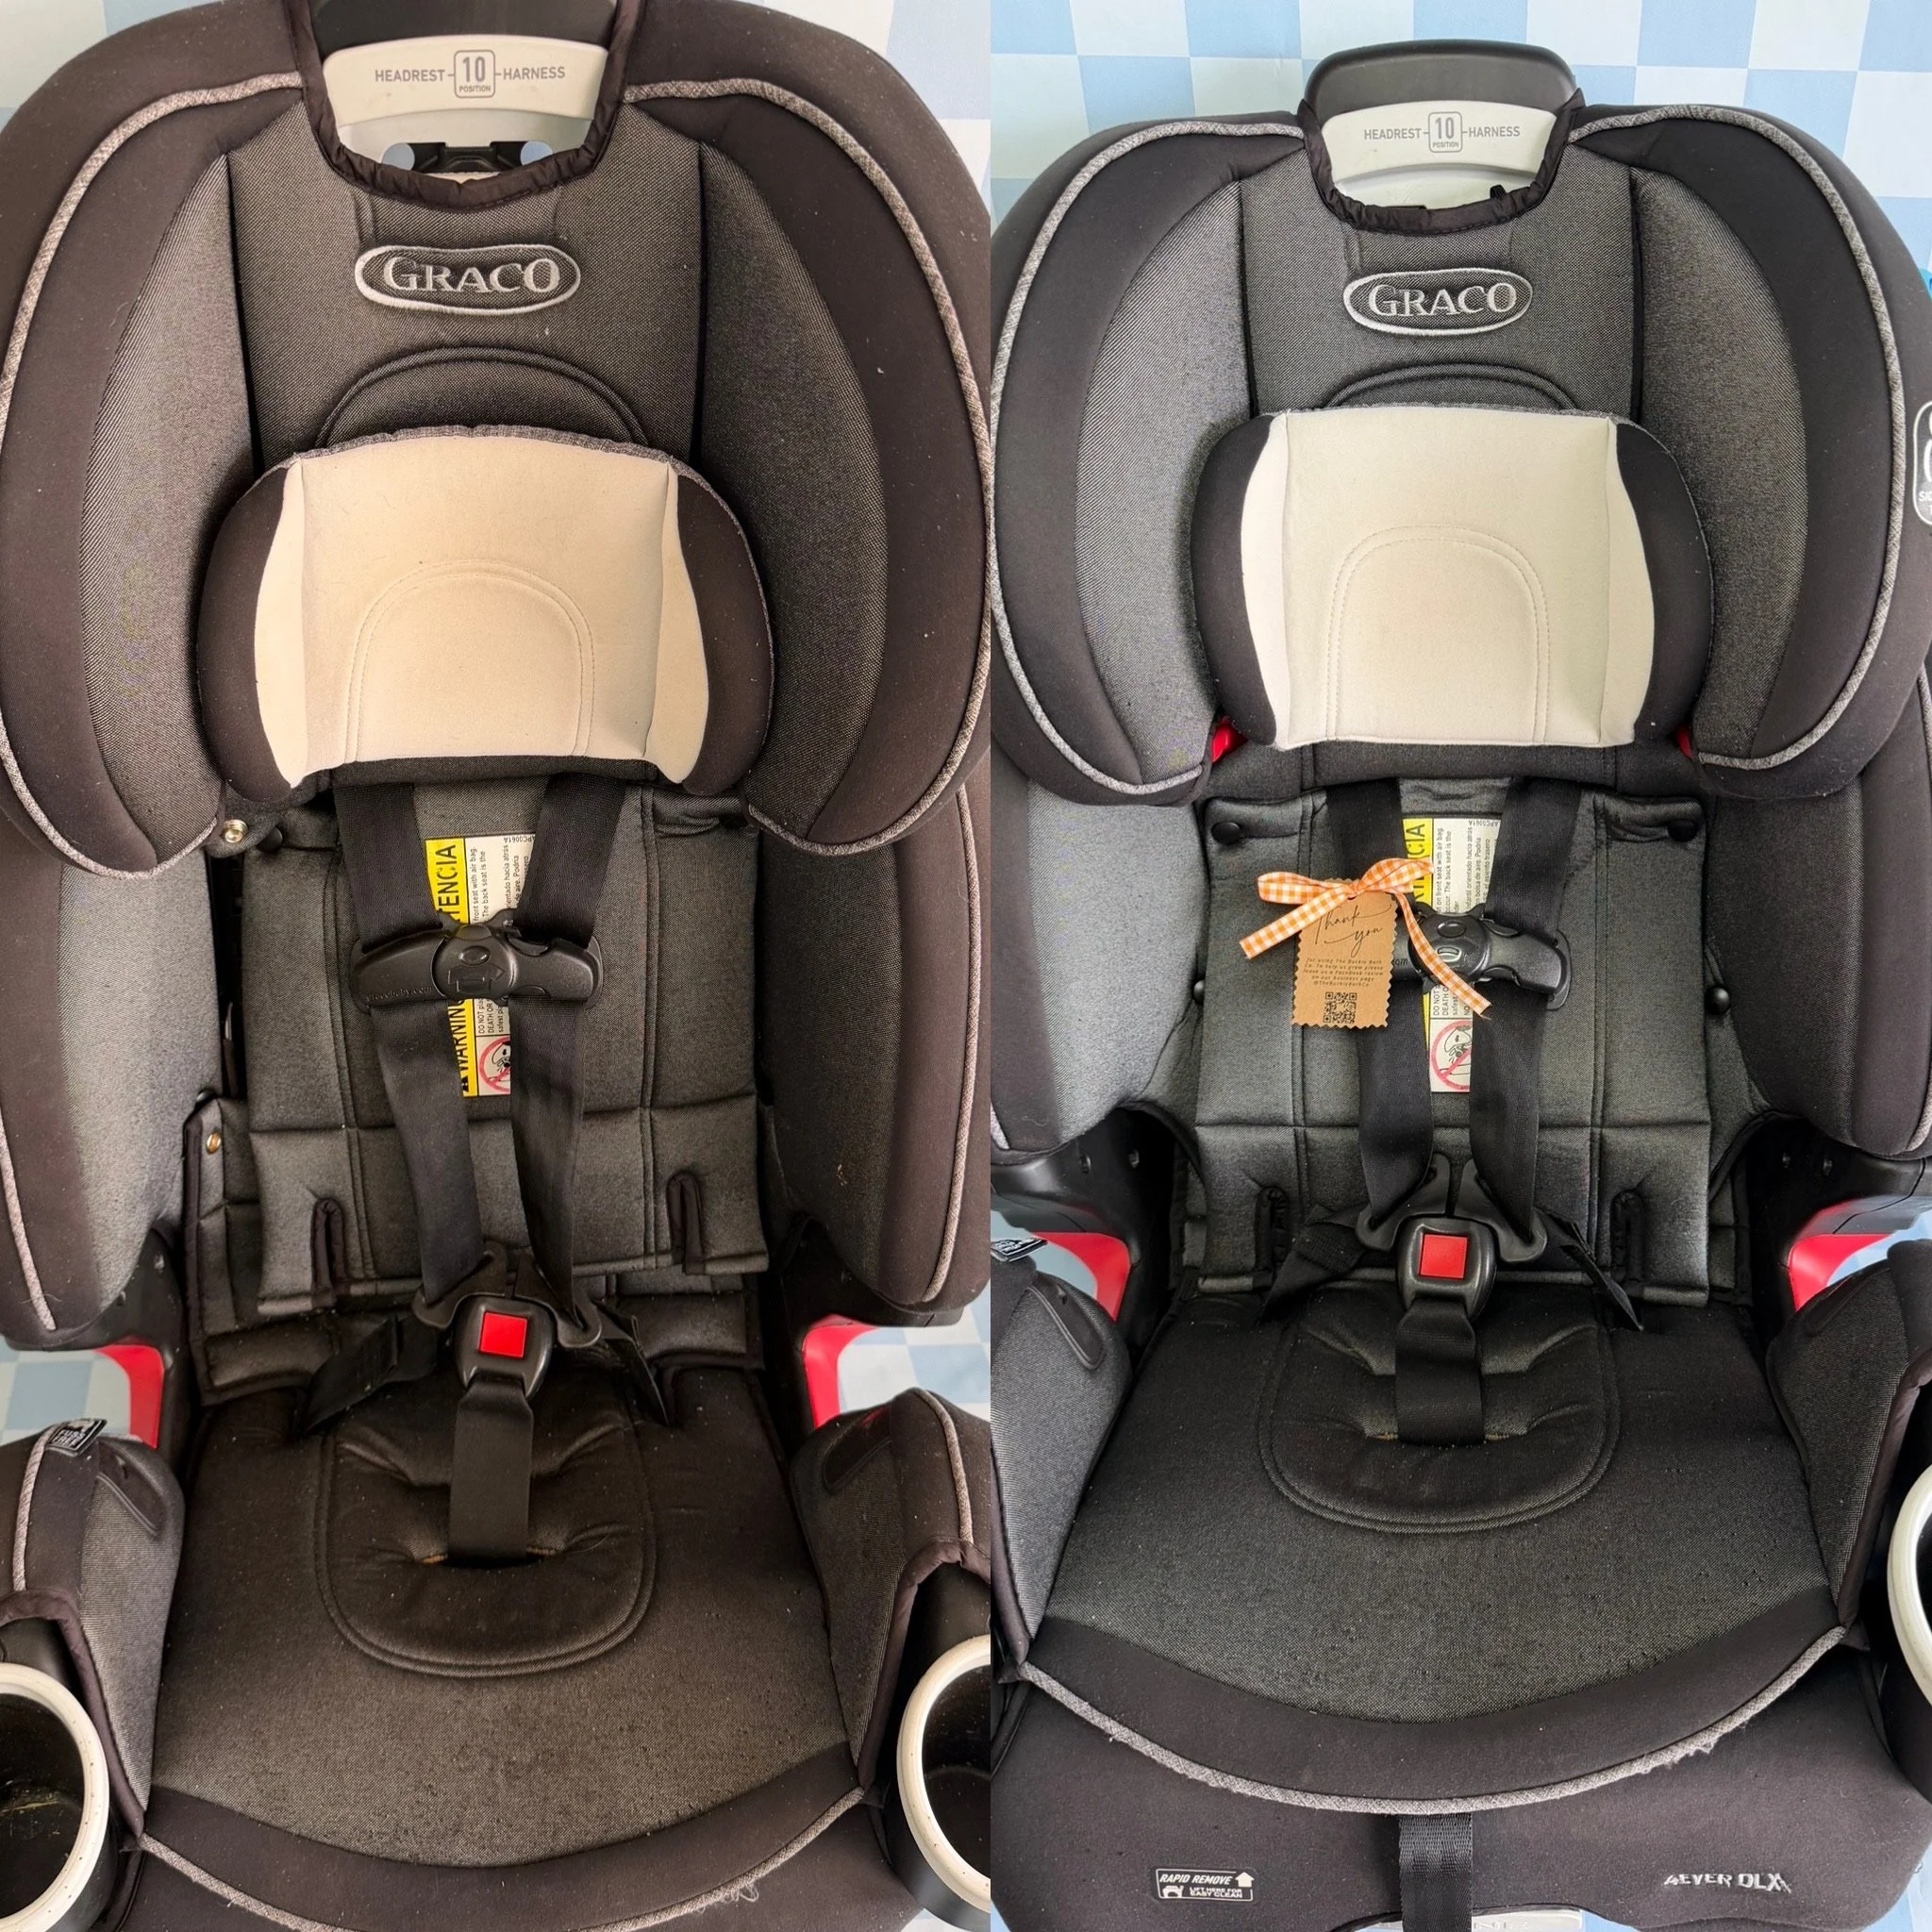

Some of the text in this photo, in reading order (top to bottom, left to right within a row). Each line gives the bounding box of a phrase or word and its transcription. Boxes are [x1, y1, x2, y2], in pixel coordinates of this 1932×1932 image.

[375, 57, 565, 81] HEADREST 10 HARNESS
[1364, 118, 1520, 140] HEADREST 10 HARNESS
[384, 257, 560, 291] GRACO
[1369, 283, 1516, 316] GRACO
[435, 845, 460, 922] TENCIA
[1315, 905, 1391, 944] Thank
[1324, 927, 1383, 958] you
[487, 1003, 493, 1011] OR
[1433, 1006, 1440, 1015] DO
[1159, 1874, 1233, 1885] RAPID REMOVE
